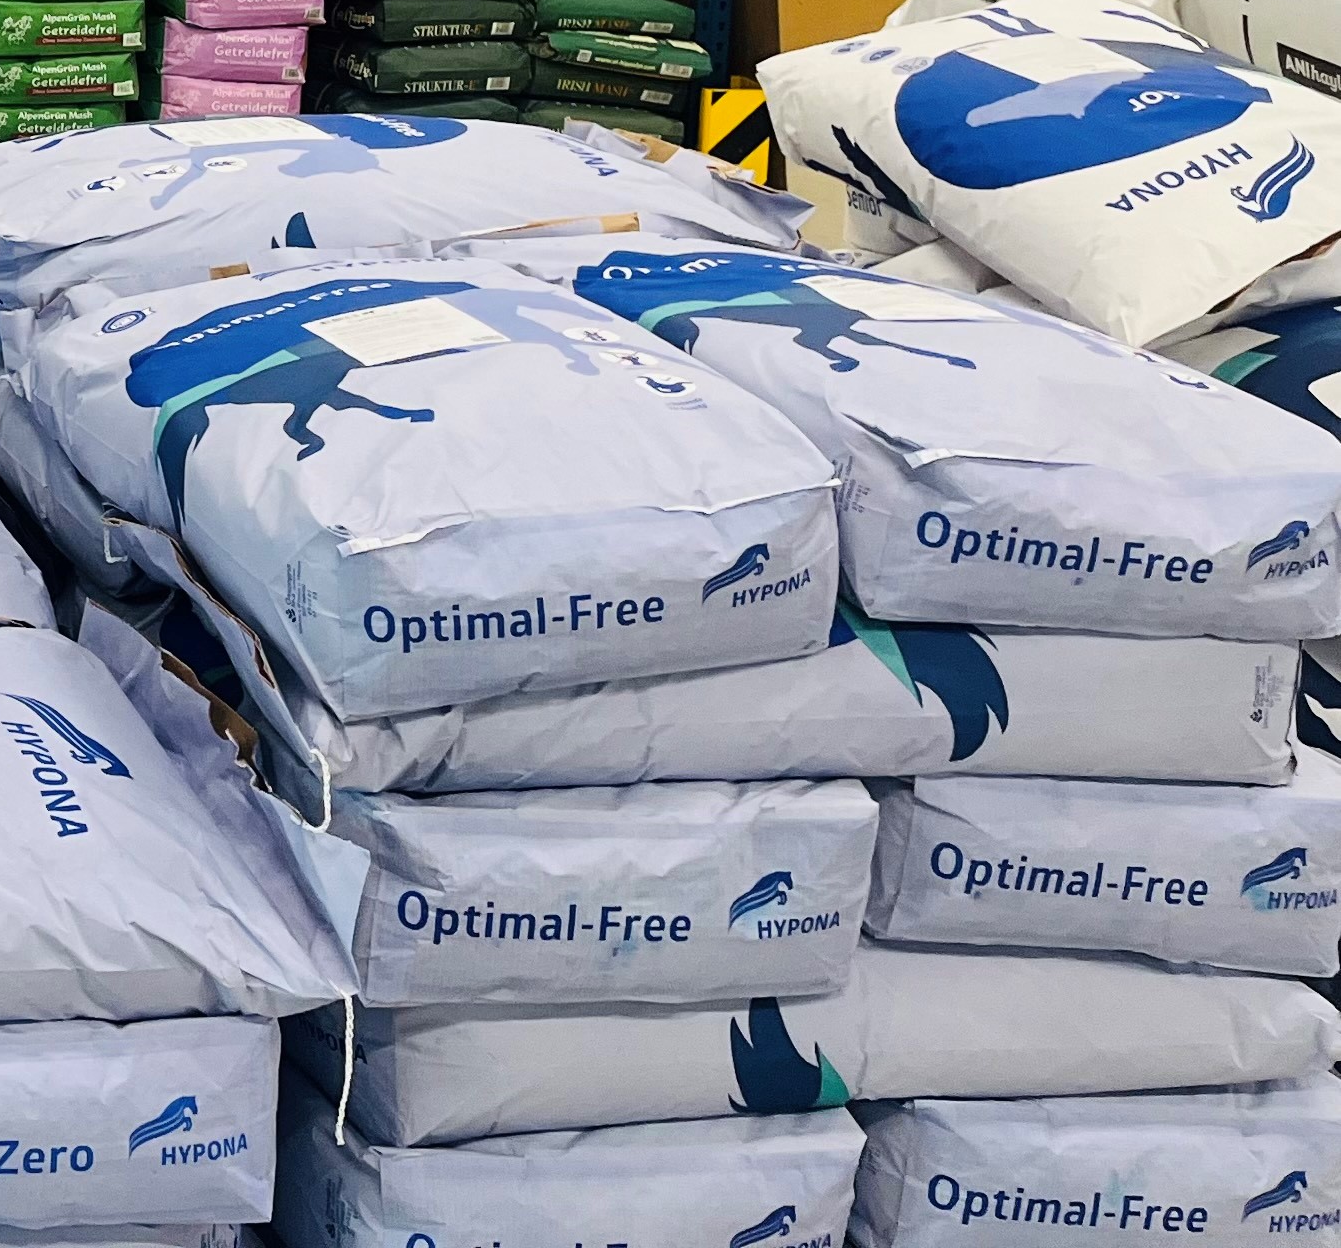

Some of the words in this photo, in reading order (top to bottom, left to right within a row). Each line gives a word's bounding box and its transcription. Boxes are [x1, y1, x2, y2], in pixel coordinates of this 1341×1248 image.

[41, 23, 117, 36] Getreidefrei
[92, 12, 116, 21] Mash
[31, 74, 107, 87] Getreidefrei
[82, 62, 107, 71] Mash
[69, 110, 93, 119] Mash
[1105, 142, 1253, 213] HYPONA
[916, 510, 1214, 584] Optimal-Free
[732, 567, 811, 608] HYPONA
[363, 594, 665, 653] Optimal-Free
[0, 721, 89, 838] HYPONA
[930, 841, 1208, 907] Optimal-Free
[397, 890, 693, 945] Optimal-Free
[1267, 889, 1338, 909] HYPONA
[757, 911, 840, 940] HYPONA
[161, 1133, 248, 1166] HYPONA
[927, 1173, 1208, 1233] Optimal-Free
